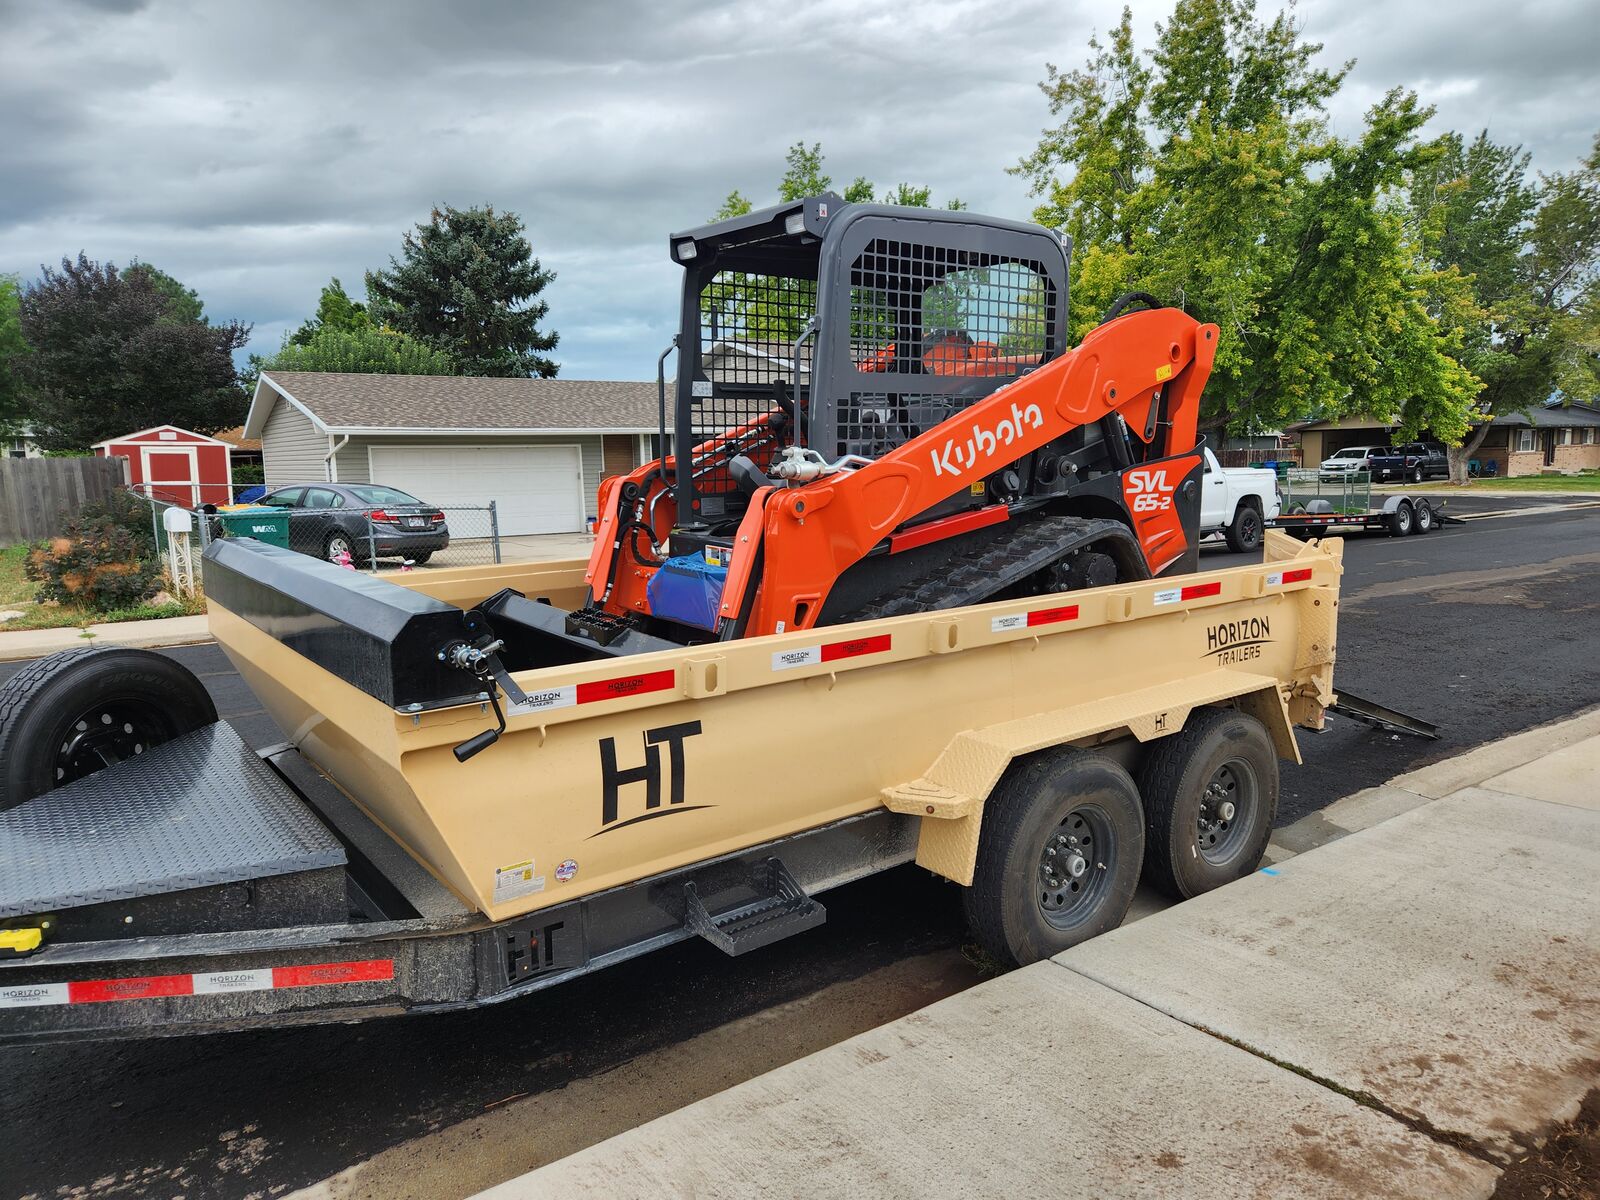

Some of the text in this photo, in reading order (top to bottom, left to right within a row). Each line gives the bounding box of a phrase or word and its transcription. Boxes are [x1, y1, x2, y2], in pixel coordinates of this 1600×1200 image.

[930, 403, 1044, 477] Kubota
[1126, 470, 1174, 494] SVL
[1133, 493, 1171, 512] 65-2
[1207, 615, 1270, 650] HORIZON
[781, 651, 809, 661] HORIZON
[1217, 646, 1261, 667] TRAILERS
[607, 679, 643, 690] HORIZON
[1155, 712, 1167, 726] HT
[599, 719, 703, 827] HT
[506, 921, 564, 981] HT
[210, 973, 255, 984] HORIZON
[2, 988, 49, 999] HORIZON
